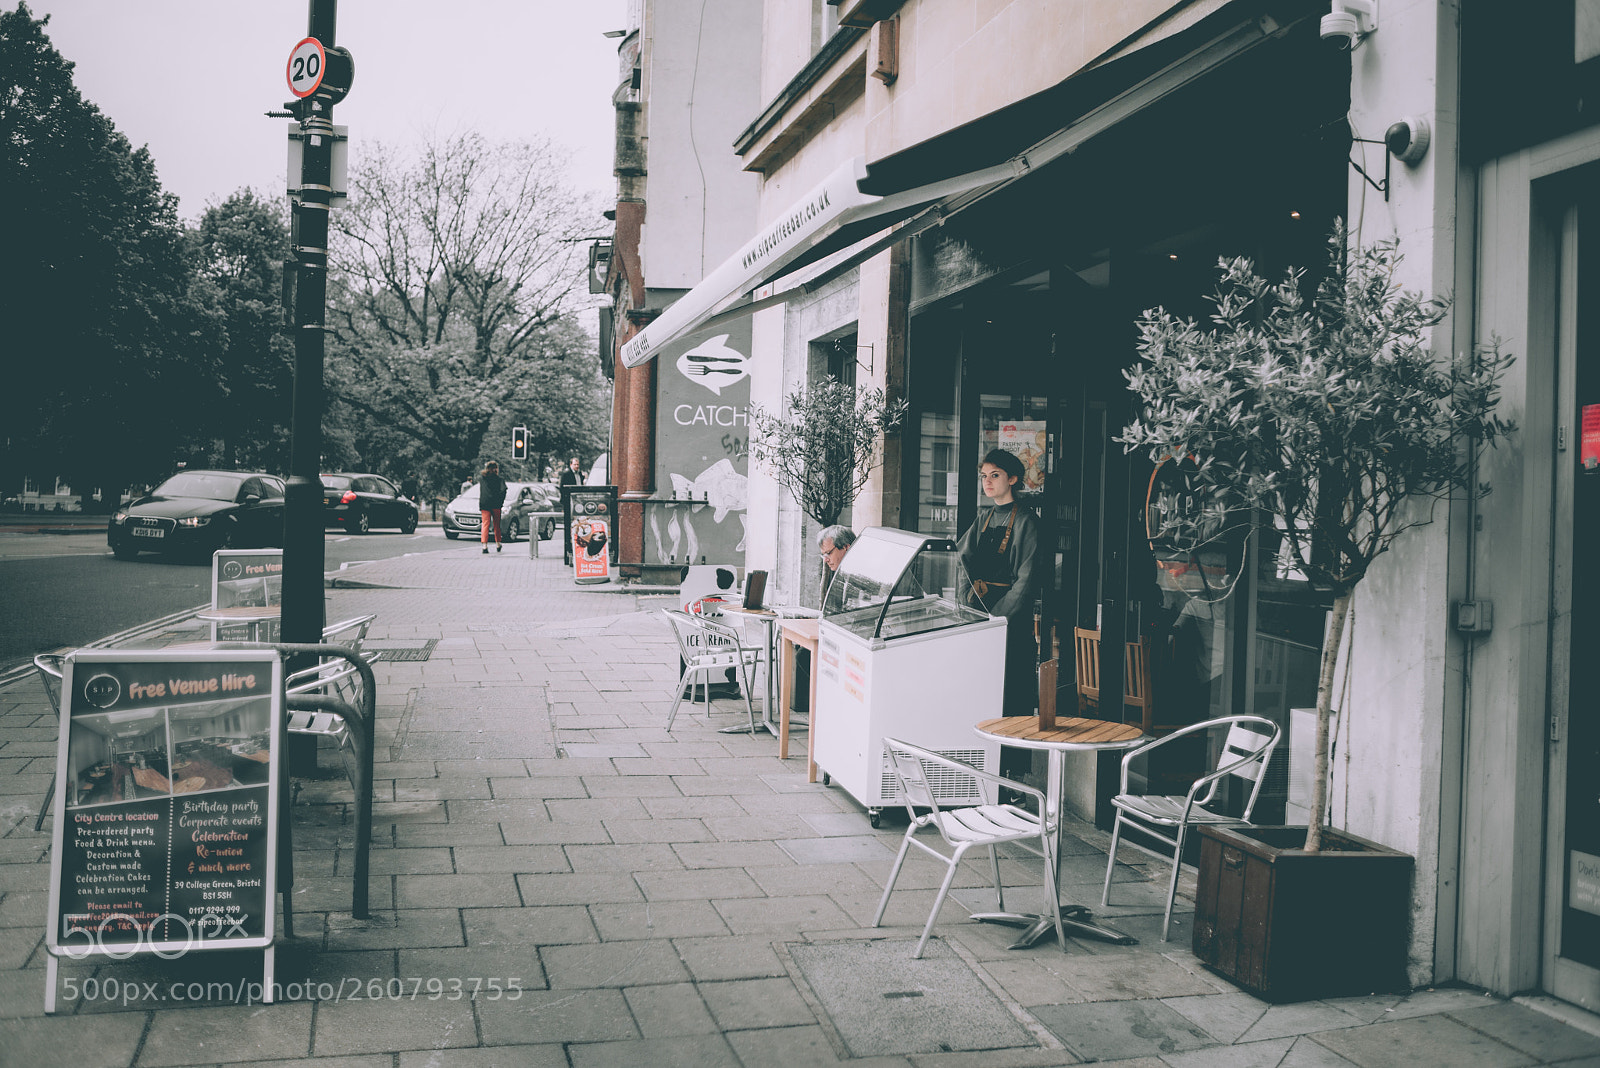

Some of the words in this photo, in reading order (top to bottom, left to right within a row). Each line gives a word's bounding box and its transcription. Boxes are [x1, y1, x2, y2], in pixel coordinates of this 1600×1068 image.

[293, 54, 319, 82] 20
[742, 187, 830, 269] www.sipcoffeebar.co.uk
[674, 404, 750, 426] CATCH
[246, 565, 264, 574] Free
[686, 635, 699, 646] ICE
[708, 634, 731, 646] REAM
[129, 682, 166, 700] Free
[169, 677, 218, 695] Venue
[222, 674, 256, 691] Hire
[183, 800, 228, 814] Birthday
[232, 799, 258, 814] party
[75, 813, 92, 824] City
[95, 813, 123, 822] Centre
[179, 815, 228, 829] Corporate
[232, 814, 262, 826] events
[77, 826, 128, 836] Pre-ordered
[131, 826, 154, 836] party
[192, 830, 248, 842] Celebration
[75, 839, 94, 848] Food
[97, 839, 103, 847] &
[106, 838, 129, 847] Drink
[87, 850, 132, 859] Decoration
[134, 850, 141, 858] &
[196, 844, 243, 858] Re-union
[87, 862, 117, 871] Custom
[120, 861, 141, 870] made
[198, 862, 223, 873] much
[226, 863, 251, 872] more
[1578, 860, 1600, 879] Don't
[76, 874, 125, 883] Celebration
[127, 873, 151, 881] Cakes
[95, 886, 105, 894] be
[108, 884, 148, 895] arranged.
[175, 881, 184, 889] 39
[186, 880, 210, 890] College
[212, 880, 235, 888] Green,
[237, 879, 261, 887] Bristol
[87, 902, 110, 910] Please
[113, 901, 132, 909] email
[206, 906, 224, 914] 9294
[117, 922, 131, 930] T&C
